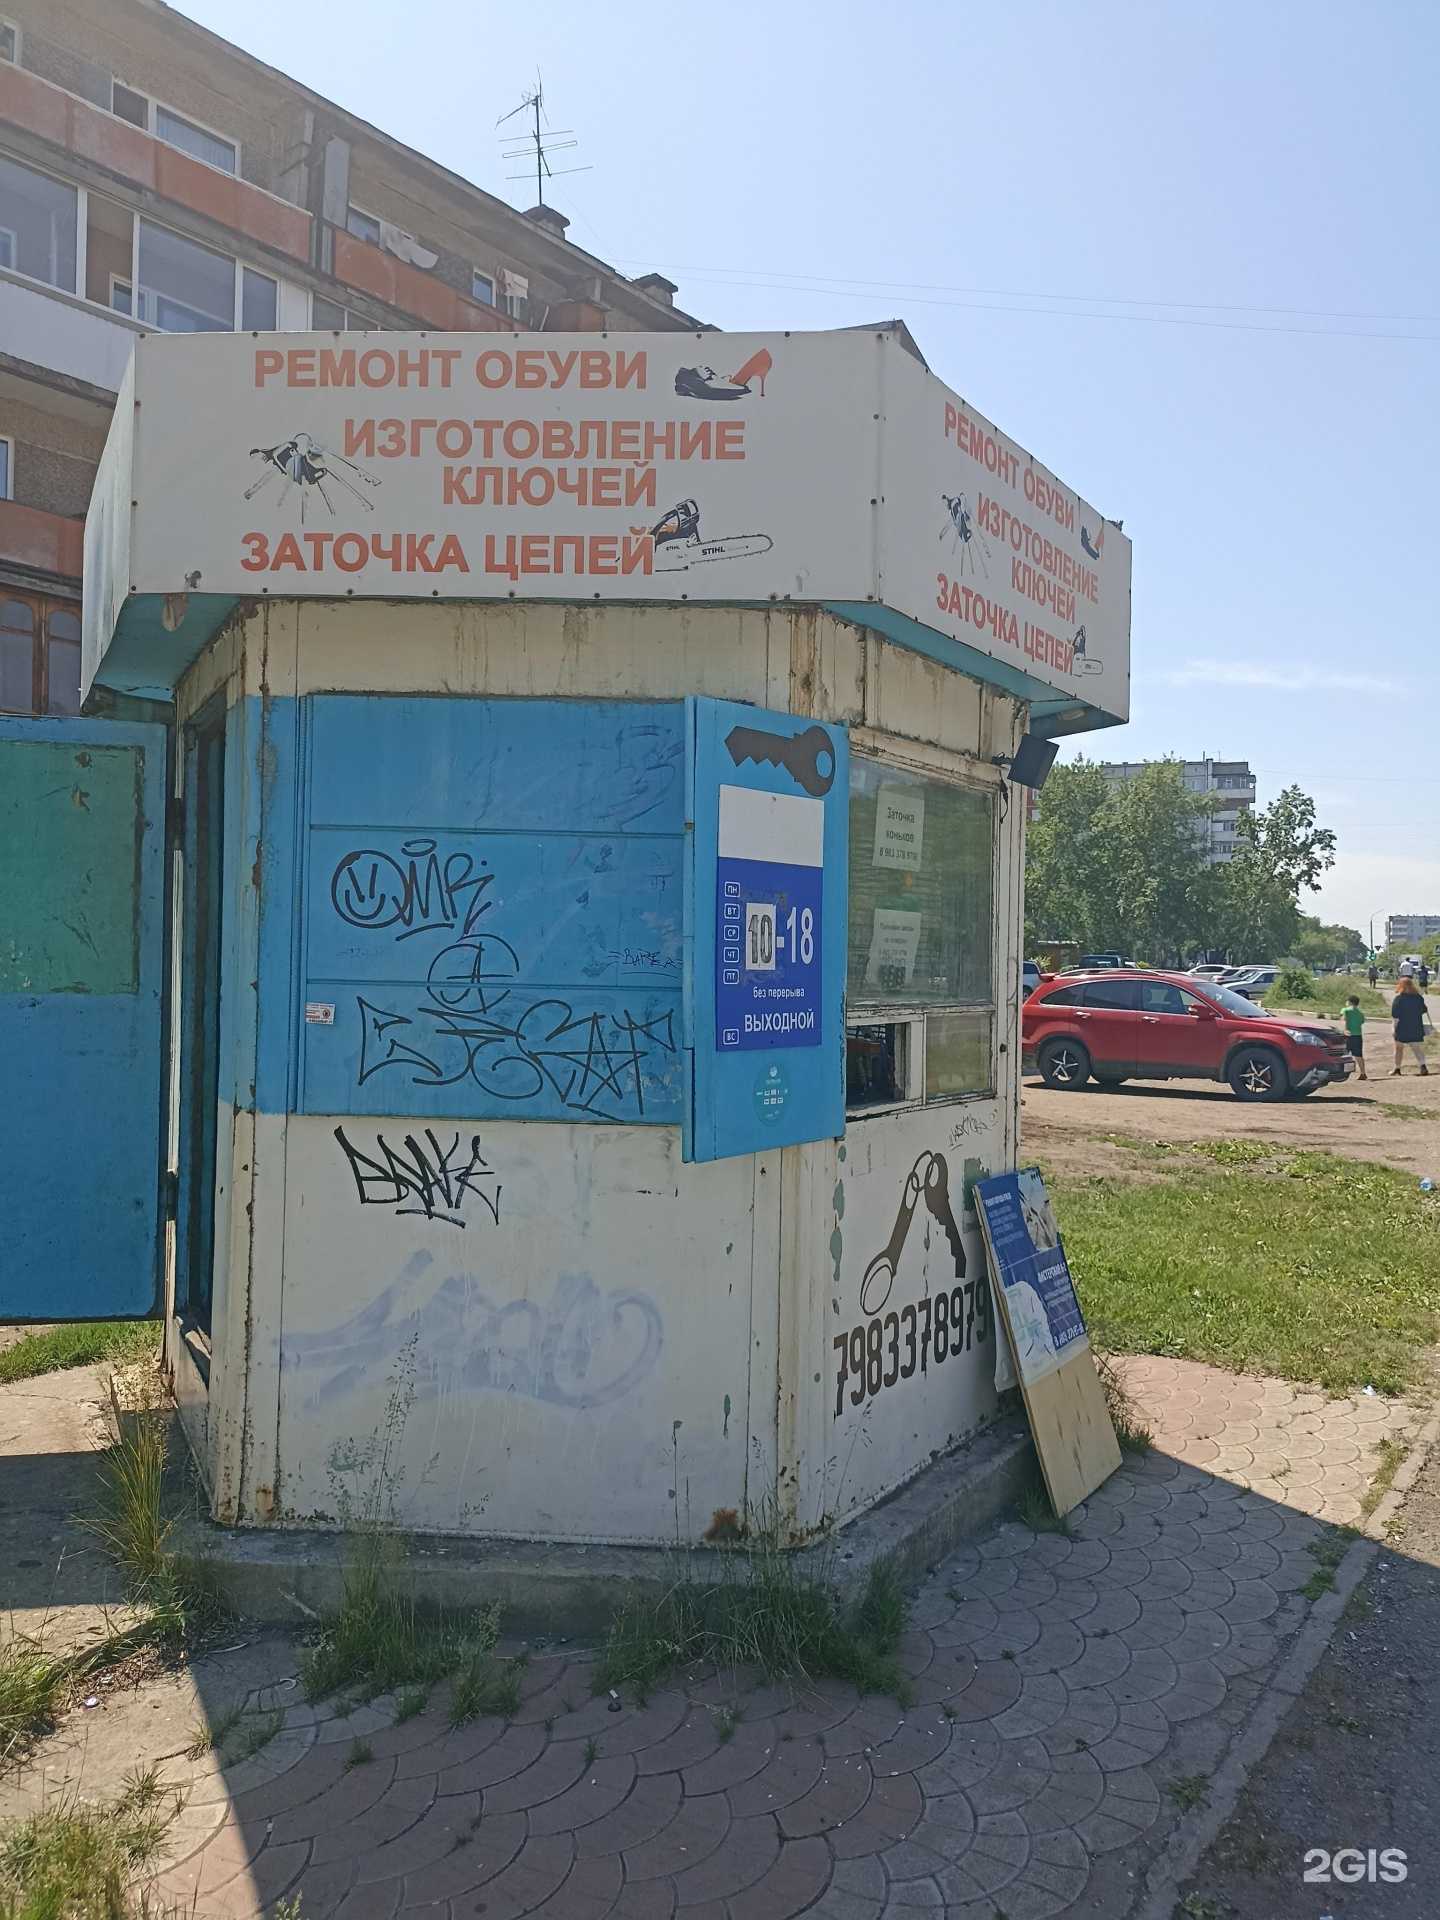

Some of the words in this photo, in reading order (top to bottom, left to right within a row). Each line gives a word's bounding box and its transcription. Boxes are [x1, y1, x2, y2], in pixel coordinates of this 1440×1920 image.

[254, 350, 461, 389] РЕМОНТ
[475, 350, 647, 390] ОБУВИ
[343, 418, 746, 461] ИЗГОТОВЛЕНИЕ
[442, 459, 657, 508] КЛЮЧЕЙ
[944, 401, 1019, 489] РЕМОНТ
[1023, 467, 1075, 533] ОБУВИ
[239, 531, 470, 574] ЗАТОЧКА
[482, 527, 655, 581] ЦЕПЕЙ
[701, 546, 726, 556] STIHL
[976, 492, 1099, 604] ИЗГОТОВЛЕНИЕ
[1011, 556, 1076, 624] КЛЮЧЕЙ
[936, 572, 1020, 649] ЗАТОЧКА
[1023, 620, 1074, 674] ЦЕПЕЙ
[748, 906, 814, 965] 10-18
[753, 986, 767, 998] без
[768, 987, 805, 1000] перерыва
[744, 1008, 814, 1033] ВЫХОДНОЙ
